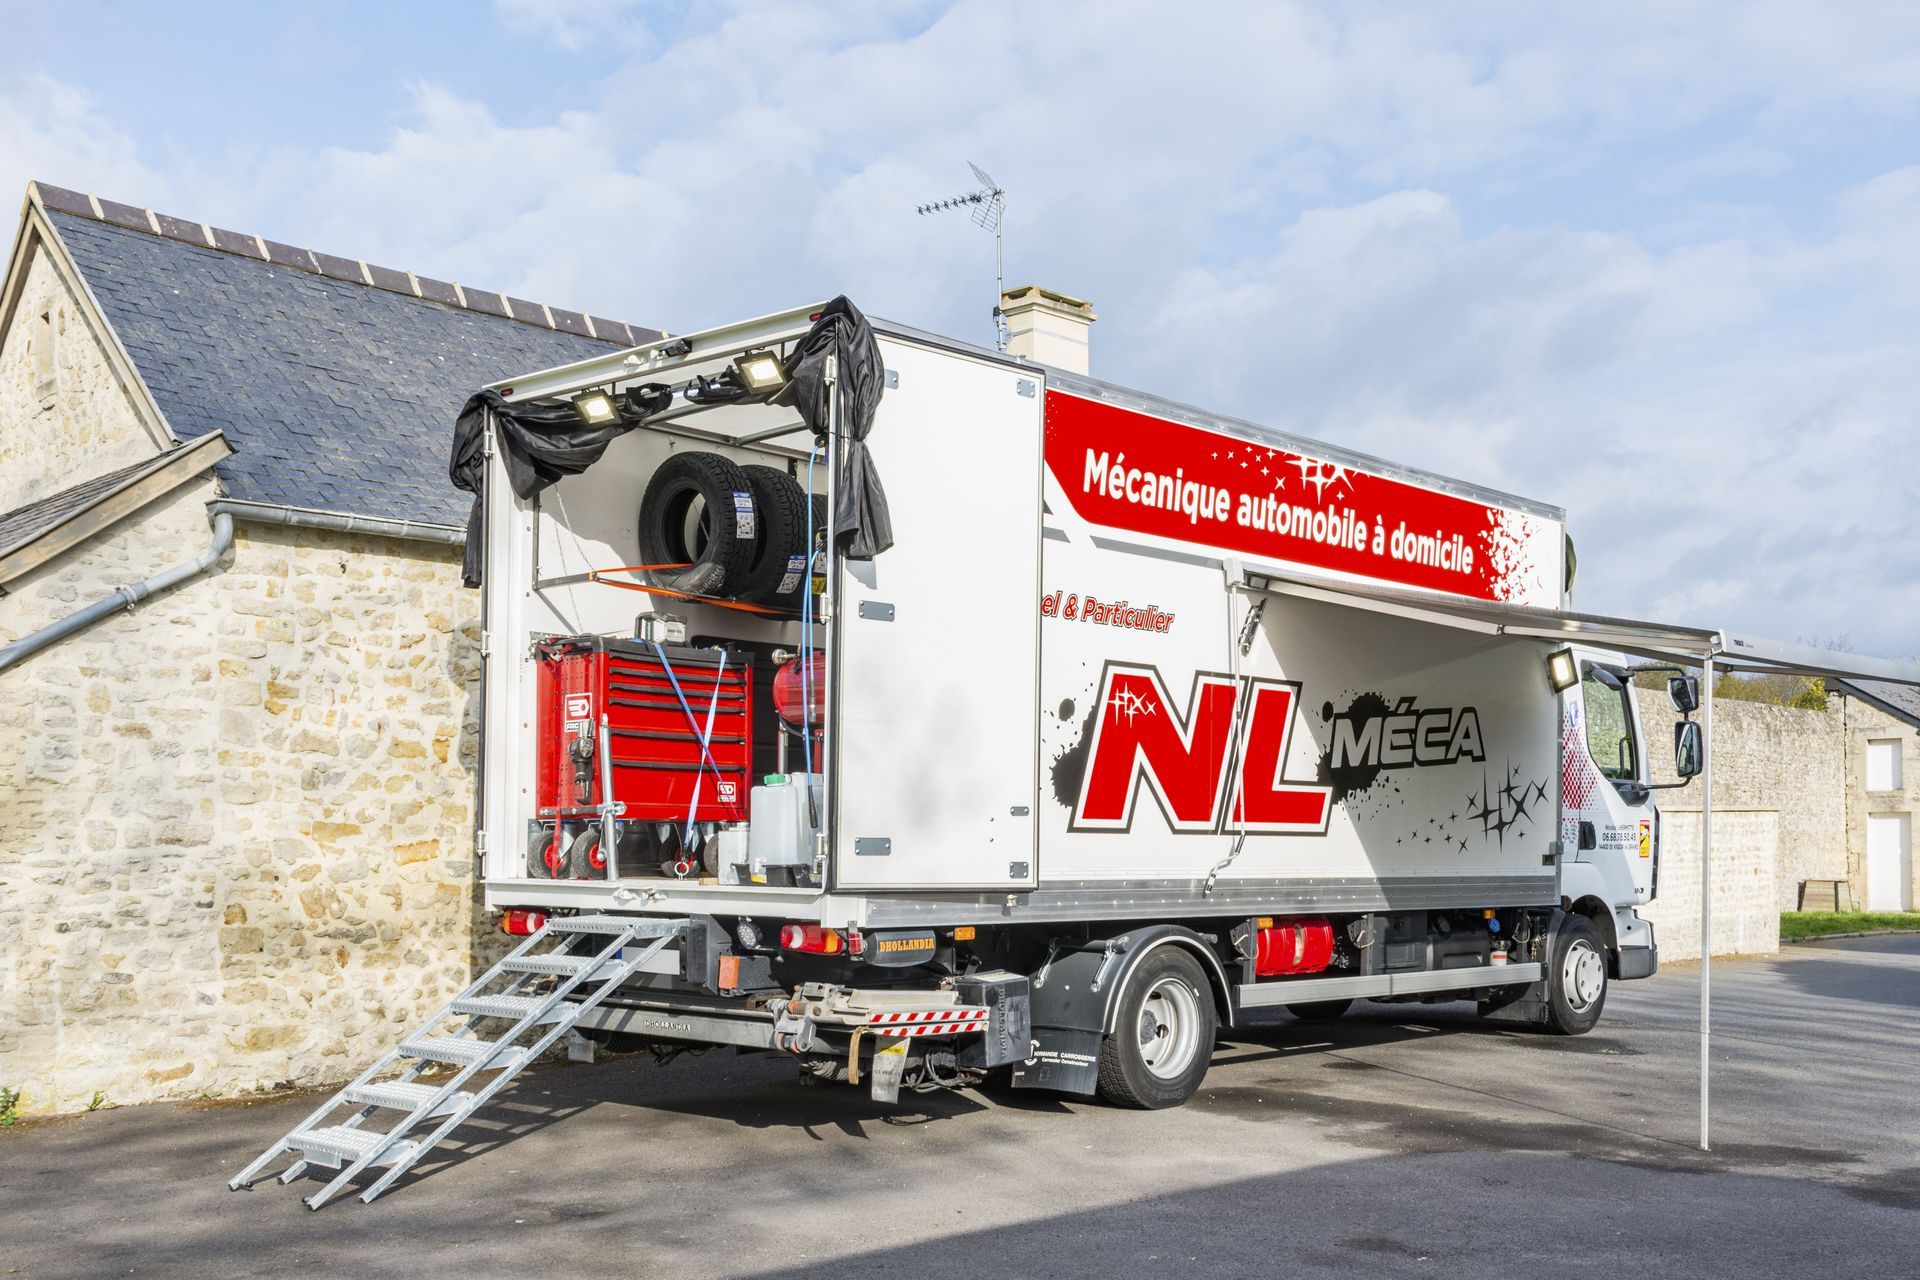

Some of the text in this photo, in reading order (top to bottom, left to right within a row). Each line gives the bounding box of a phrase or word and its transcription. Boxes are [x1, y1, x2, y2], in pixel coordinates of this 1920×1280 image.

[1083, 448, 1474, 575] Mécanique automobile à domicile
[1062, 593, 1079, 621] &
[1081, 596, 1175, 633] Particulier
[1067, 659, 1486, 837] NL MÉCA
[879, 938, 935, 952] DHOLLANDIA
[645, 1019, 690, 1032] DHOLLANDIA
[1060, 1052, 1097, 1063] CARROSSERIE
